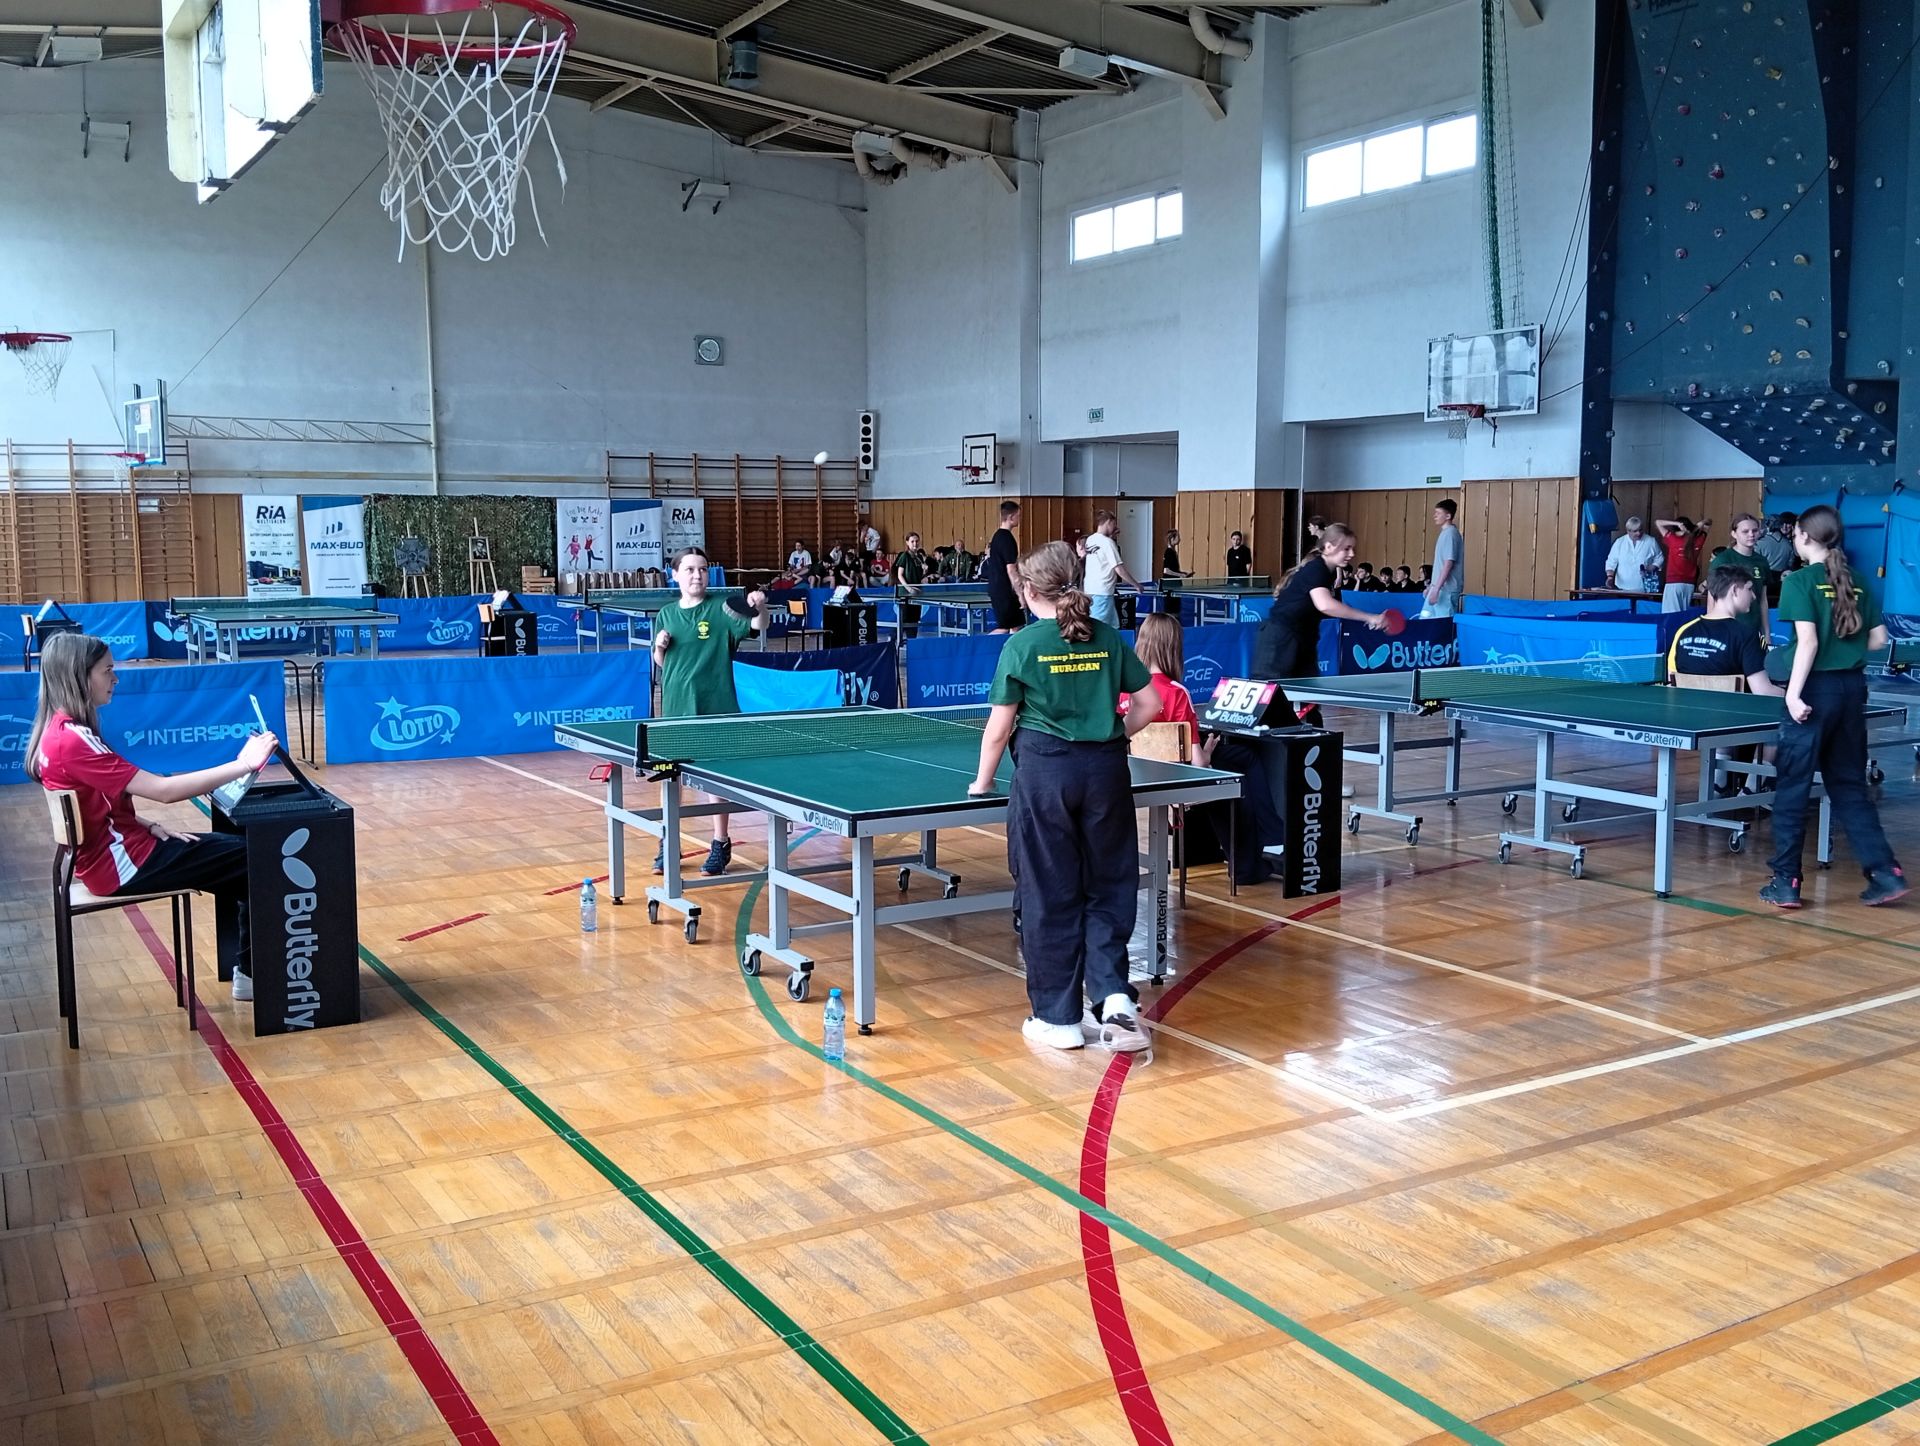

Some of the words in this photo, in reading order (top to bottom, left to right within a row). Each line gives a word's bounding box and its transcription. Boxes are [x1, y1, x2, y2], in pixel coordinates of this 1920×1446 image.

[256, 505, 286, 519] RiA
[672, 508, 695, 520] RiA
[310, 541, 364, 550] MAX-BUD
[616, 541, 661, 549] MAX-BUD
[435, 624, 464, 640] LOTTO
[1050, 662, 1100, 674] HURAGAN
[1184, 667, 1213, 682] PGE
[1222, 685, 1238, 707] 5
[1241, 687, 1257, 710] 5
[534, 705, 634, 726] INTERSPORT
[1219, 711, 1257, 728] Butterfly
[388, 712, 444, 742] LOTTO
[1643, 733, 1684, 748] Butterfly
[814, 812, 844, 833] Butterfly
[1301, 793, 1323, 894] Butterfly
[1157, 889, 1168, 942] Butterfly
[283, 891, 322, 1029] Butterfly
